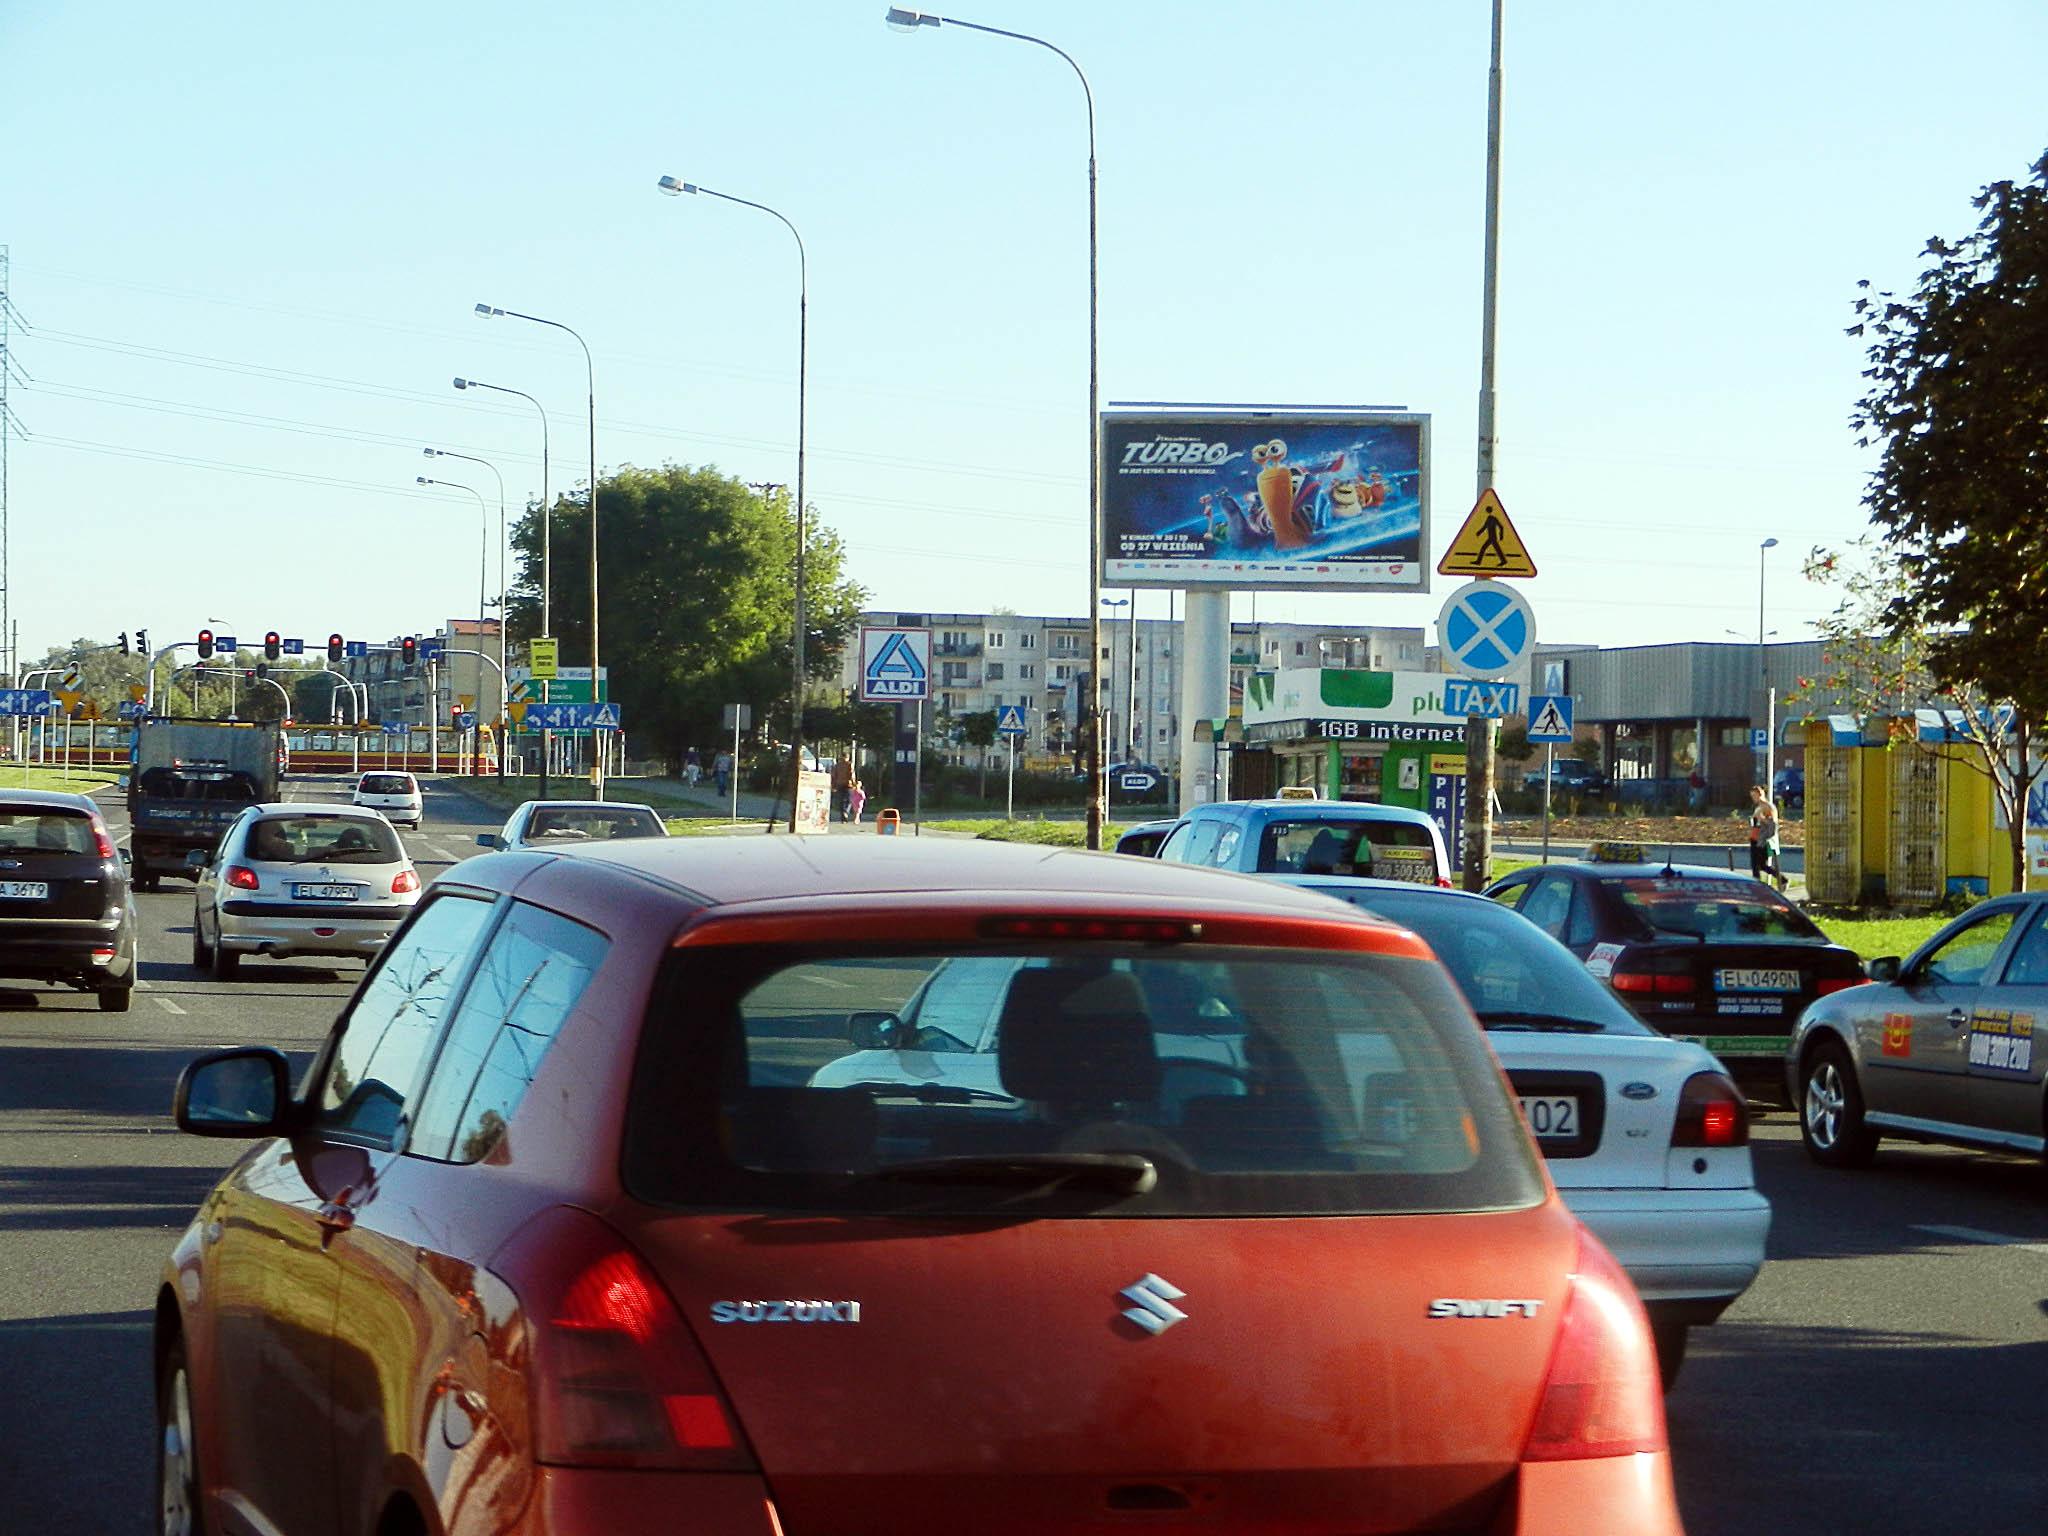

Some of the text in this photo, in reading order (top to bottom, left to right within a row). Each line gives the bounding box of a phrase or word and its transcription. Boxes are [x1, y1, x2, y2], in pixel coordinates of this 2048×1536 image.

[1121, 442, 1232, 465] TURBO
[1120, 541, 1205, 551] OD 27 WRZEŚNIA
[872, 681, 919, 694] ALDI
[1449, 683, 1516, 714] TAXI
[1317, 720, 1359, 739] 1GB
[1370, 722, 1465, 742] internet
[1520, 1100, 1574, 1134] 02
[710, 1300, 861, 1323] SUZUKI
[1428, 1298, 1545, 1319] SWIFT
